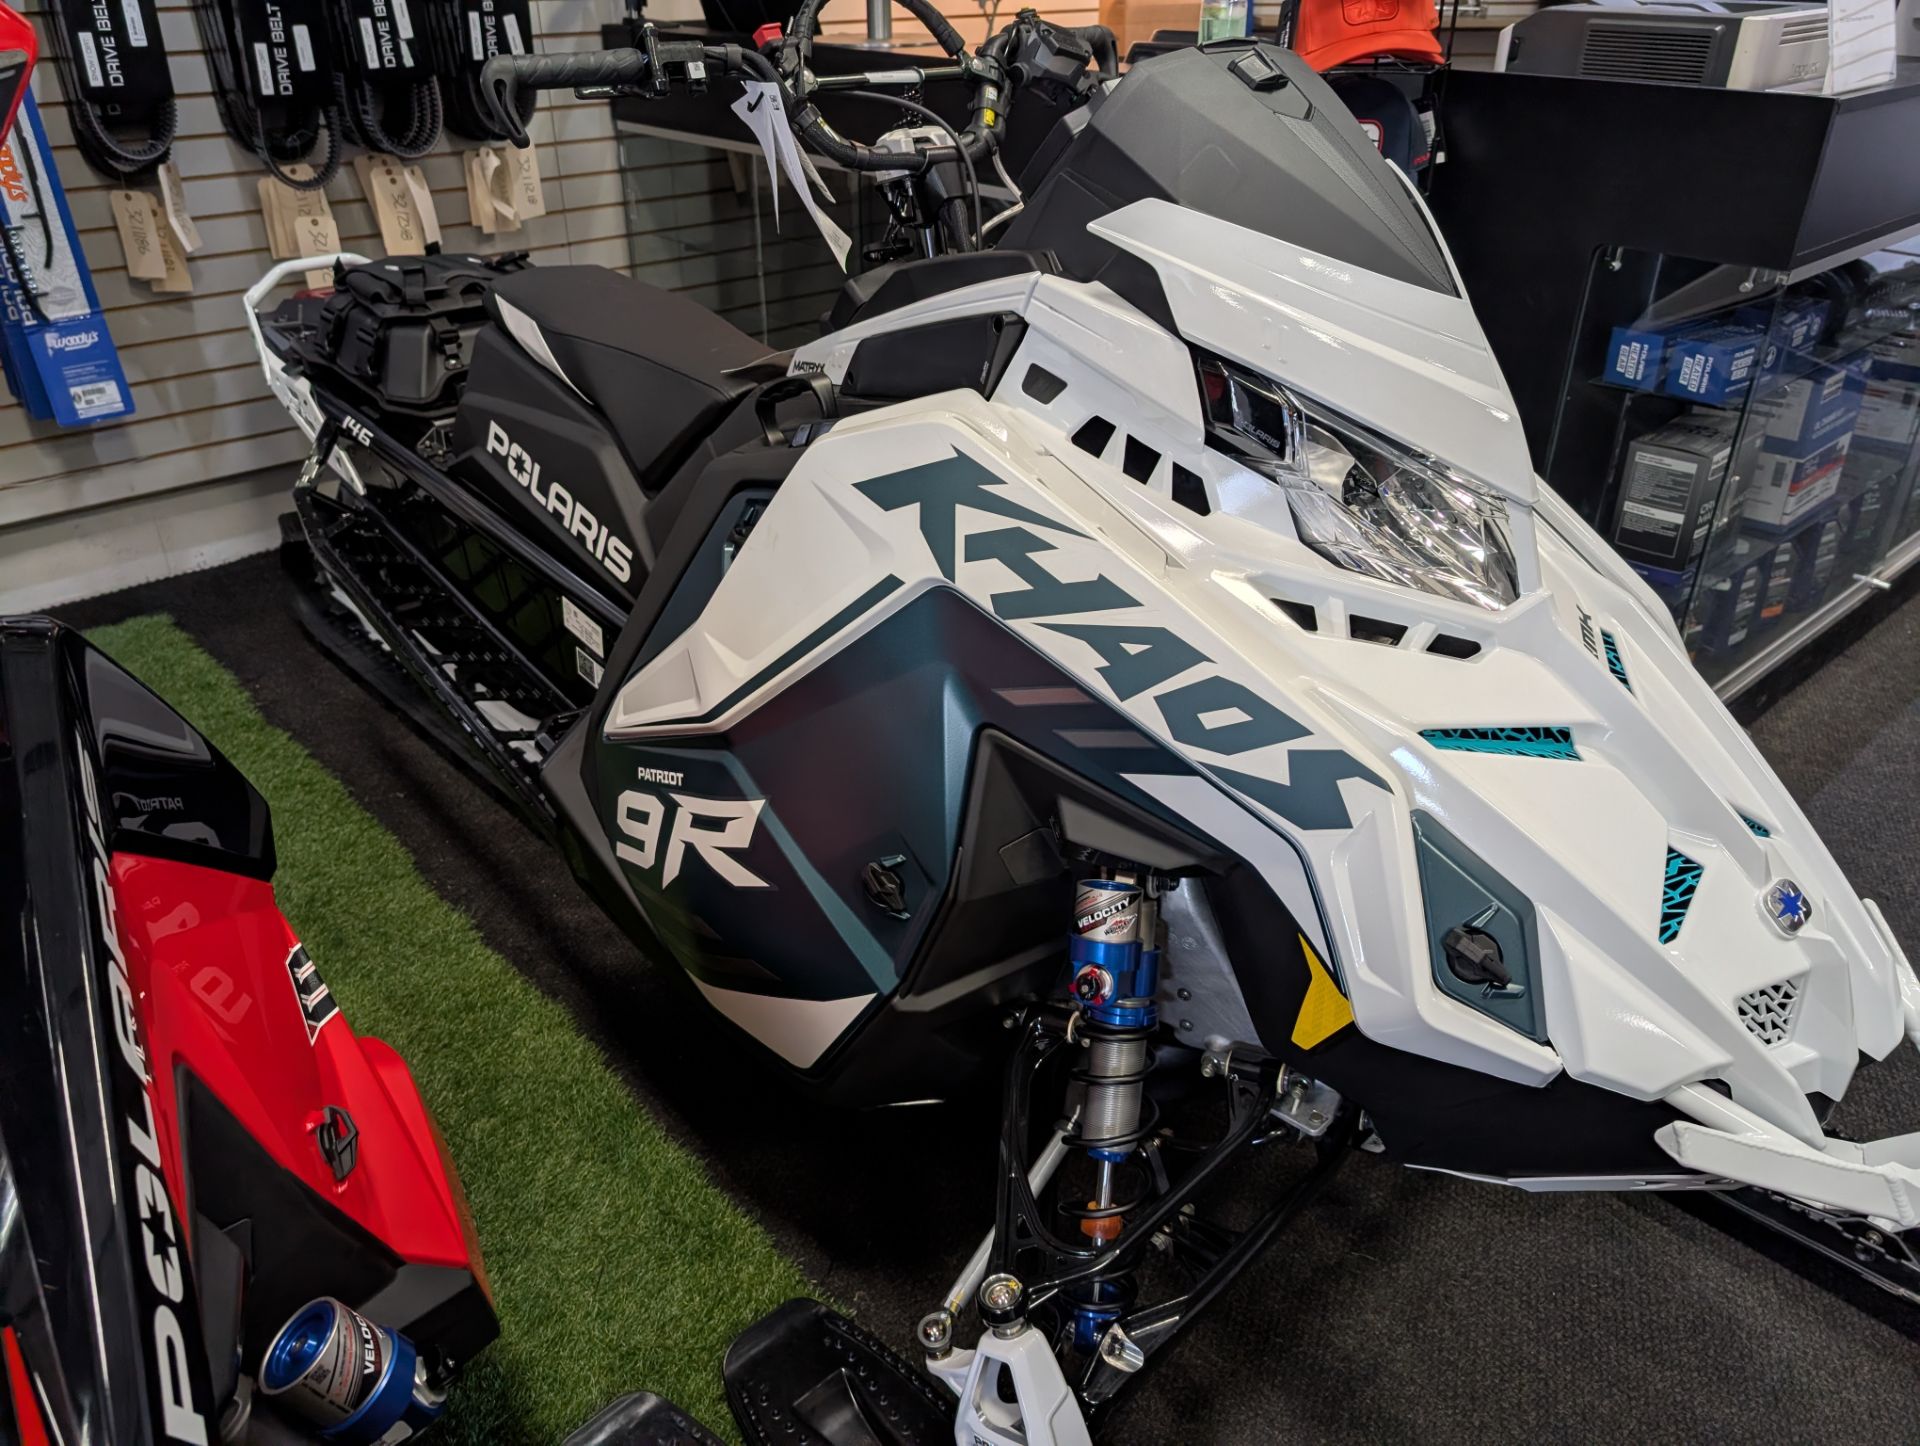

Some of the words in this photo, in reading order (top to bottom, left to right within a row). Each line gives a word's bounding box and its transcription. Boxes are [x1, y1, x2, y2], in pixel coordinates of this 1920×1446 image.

[92, 0, 111, 31] BEL
[267, 3, 285, 43] BELT
[373, 0, 388, 14] BE
[377, 19, 396, 68] DRIVE
[487, 16, 499, 58] DRIVE
[103, 35, 124, 87] DRIVE
[270, 47, 293, 95] DRIVE
[793, 360, 826, 373] MATRYX
[1617, 346, 1629, 373] GEAR
[1626, 343, 1640, 379] HEATED
[1636, 344, 1649, 380] POLARIS
[1680, 358, 1693, 384] GEAR
[1688, 355, 1704, 392] HEATED
[1699, 357, 1714, 393] POLARIS
[343, 415, 374, 447] 146
[486, 420, 633, 583] POLARIS
[852, 445, 1395, 830] KHAOS
[637, 766, 684, 786] PATRIOT
[616, 789, 771, 890] 9R
[1078, 897, 1130, 929] VELOCITY
[75, 720, 208, 1446] POLARIS
